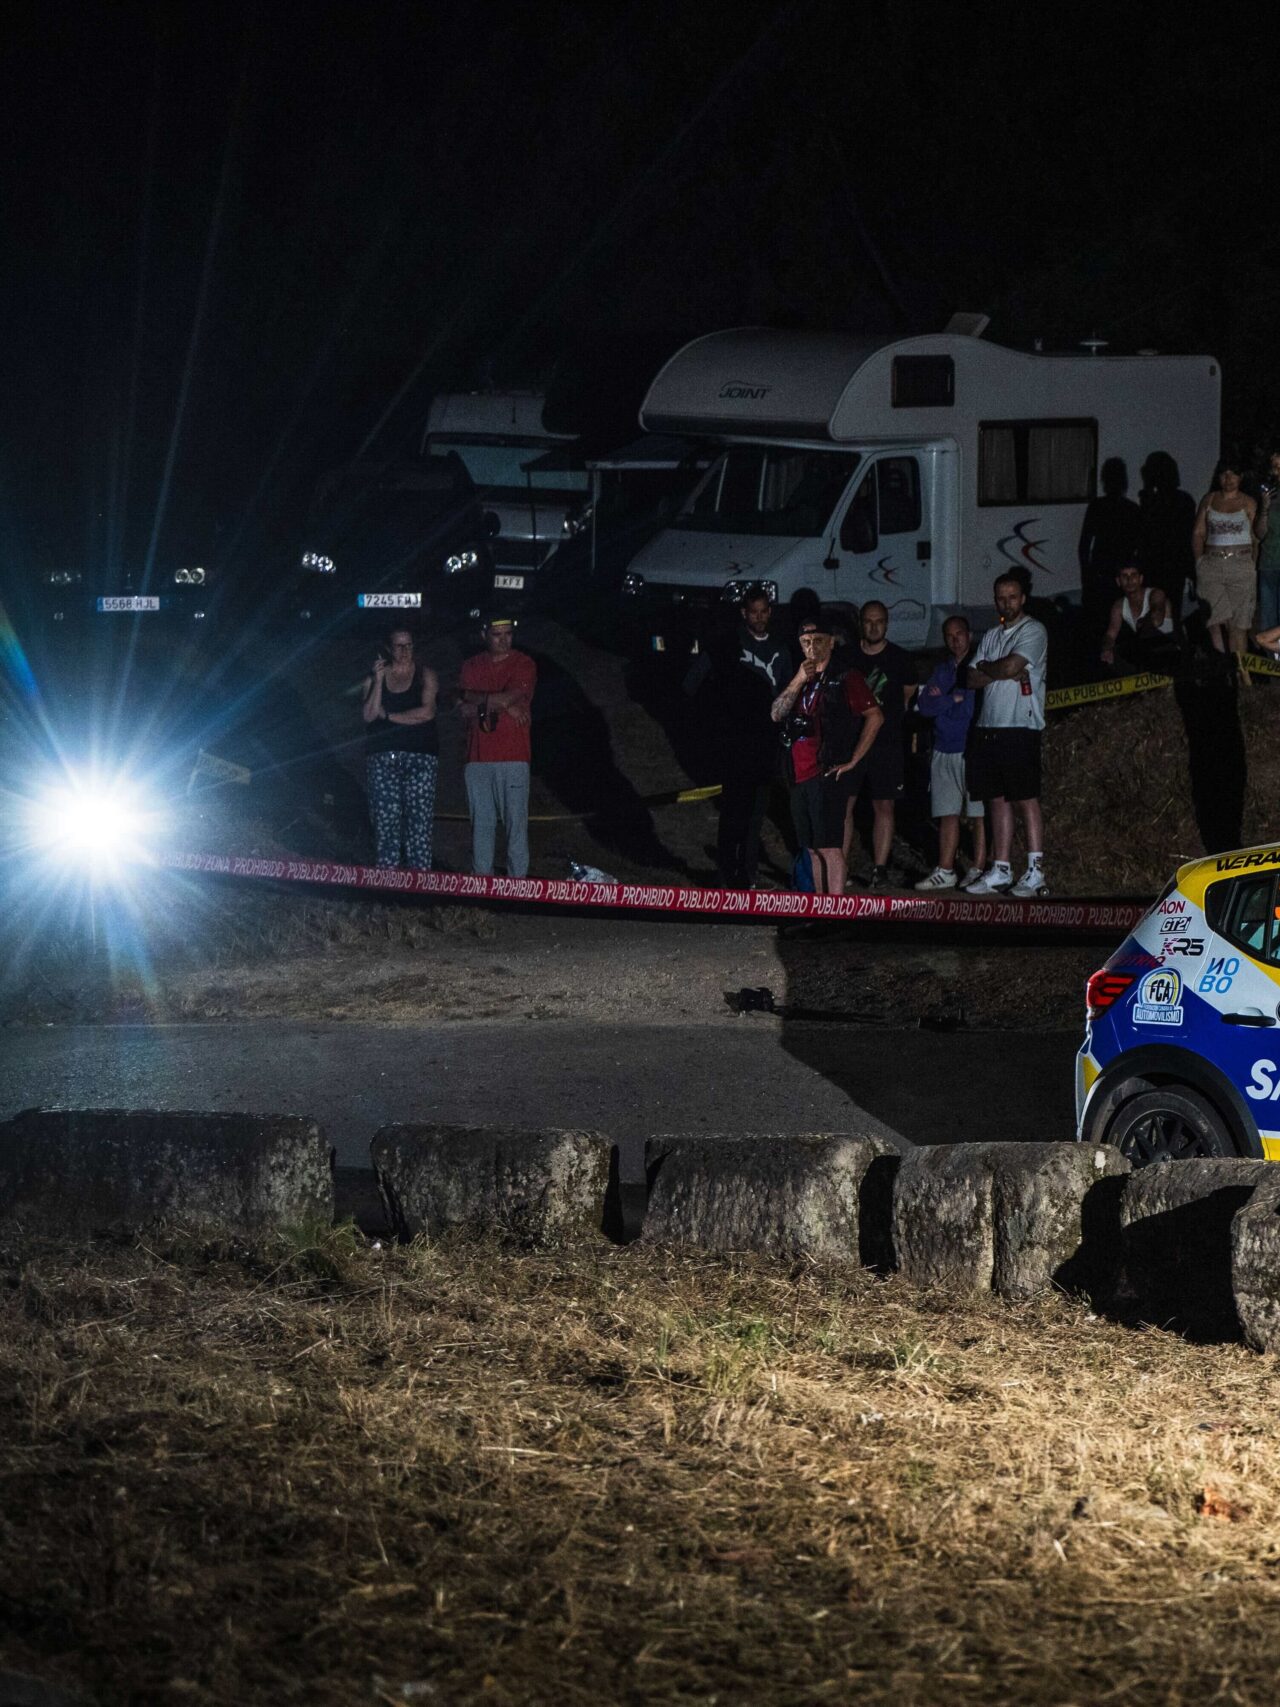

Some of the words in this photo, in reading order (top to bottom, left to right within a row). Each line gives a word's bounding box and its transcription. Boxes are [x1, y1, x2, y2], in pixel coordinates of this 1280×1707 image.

[105, 598, 132, 609] 5568
[366, 595, 394, 606] 7245
[1073, 680, 1123, 701] PUBLICO
[204, 857, 230, 872] ZONA
[233, 857, 284, 878] PROHIBIDO
[286, 862, 329, 881] PUBLICO
[331, 865, 358, 885] ZONA
[361, 868, 412, 889] PROHIBIDO
[416, 872, 458, 892] PUBLICO
[460, 876, 488, 894] ZONA
[491, 878, 543, 899] PROHIBIDO
[545, 881, 588, 901] PUBLICO
[590, 884, 618, 903] ZONA
[620, 886, 674, 908] PROHIBIDO
[676, 889, 721, 910] PUBLICO
[722, 891, 750, 911] ZONA
[753, 893, 808, 914] PROHIBIDO
[810, 896, 856, 916] PUBLICO
[857, 898, 885, 917] ZONA
[888, 899, 944, 920] PROHIBIDO
[947, 901, 992, 922] PUBLICO
[995, 903, 1024, 923] ZONA
[1027, 904, 1083, 925] PROHIBIDO
[1087, 906, 1134, 927] PUBLICO
[1149, 978, 1171, 1002] FCA
